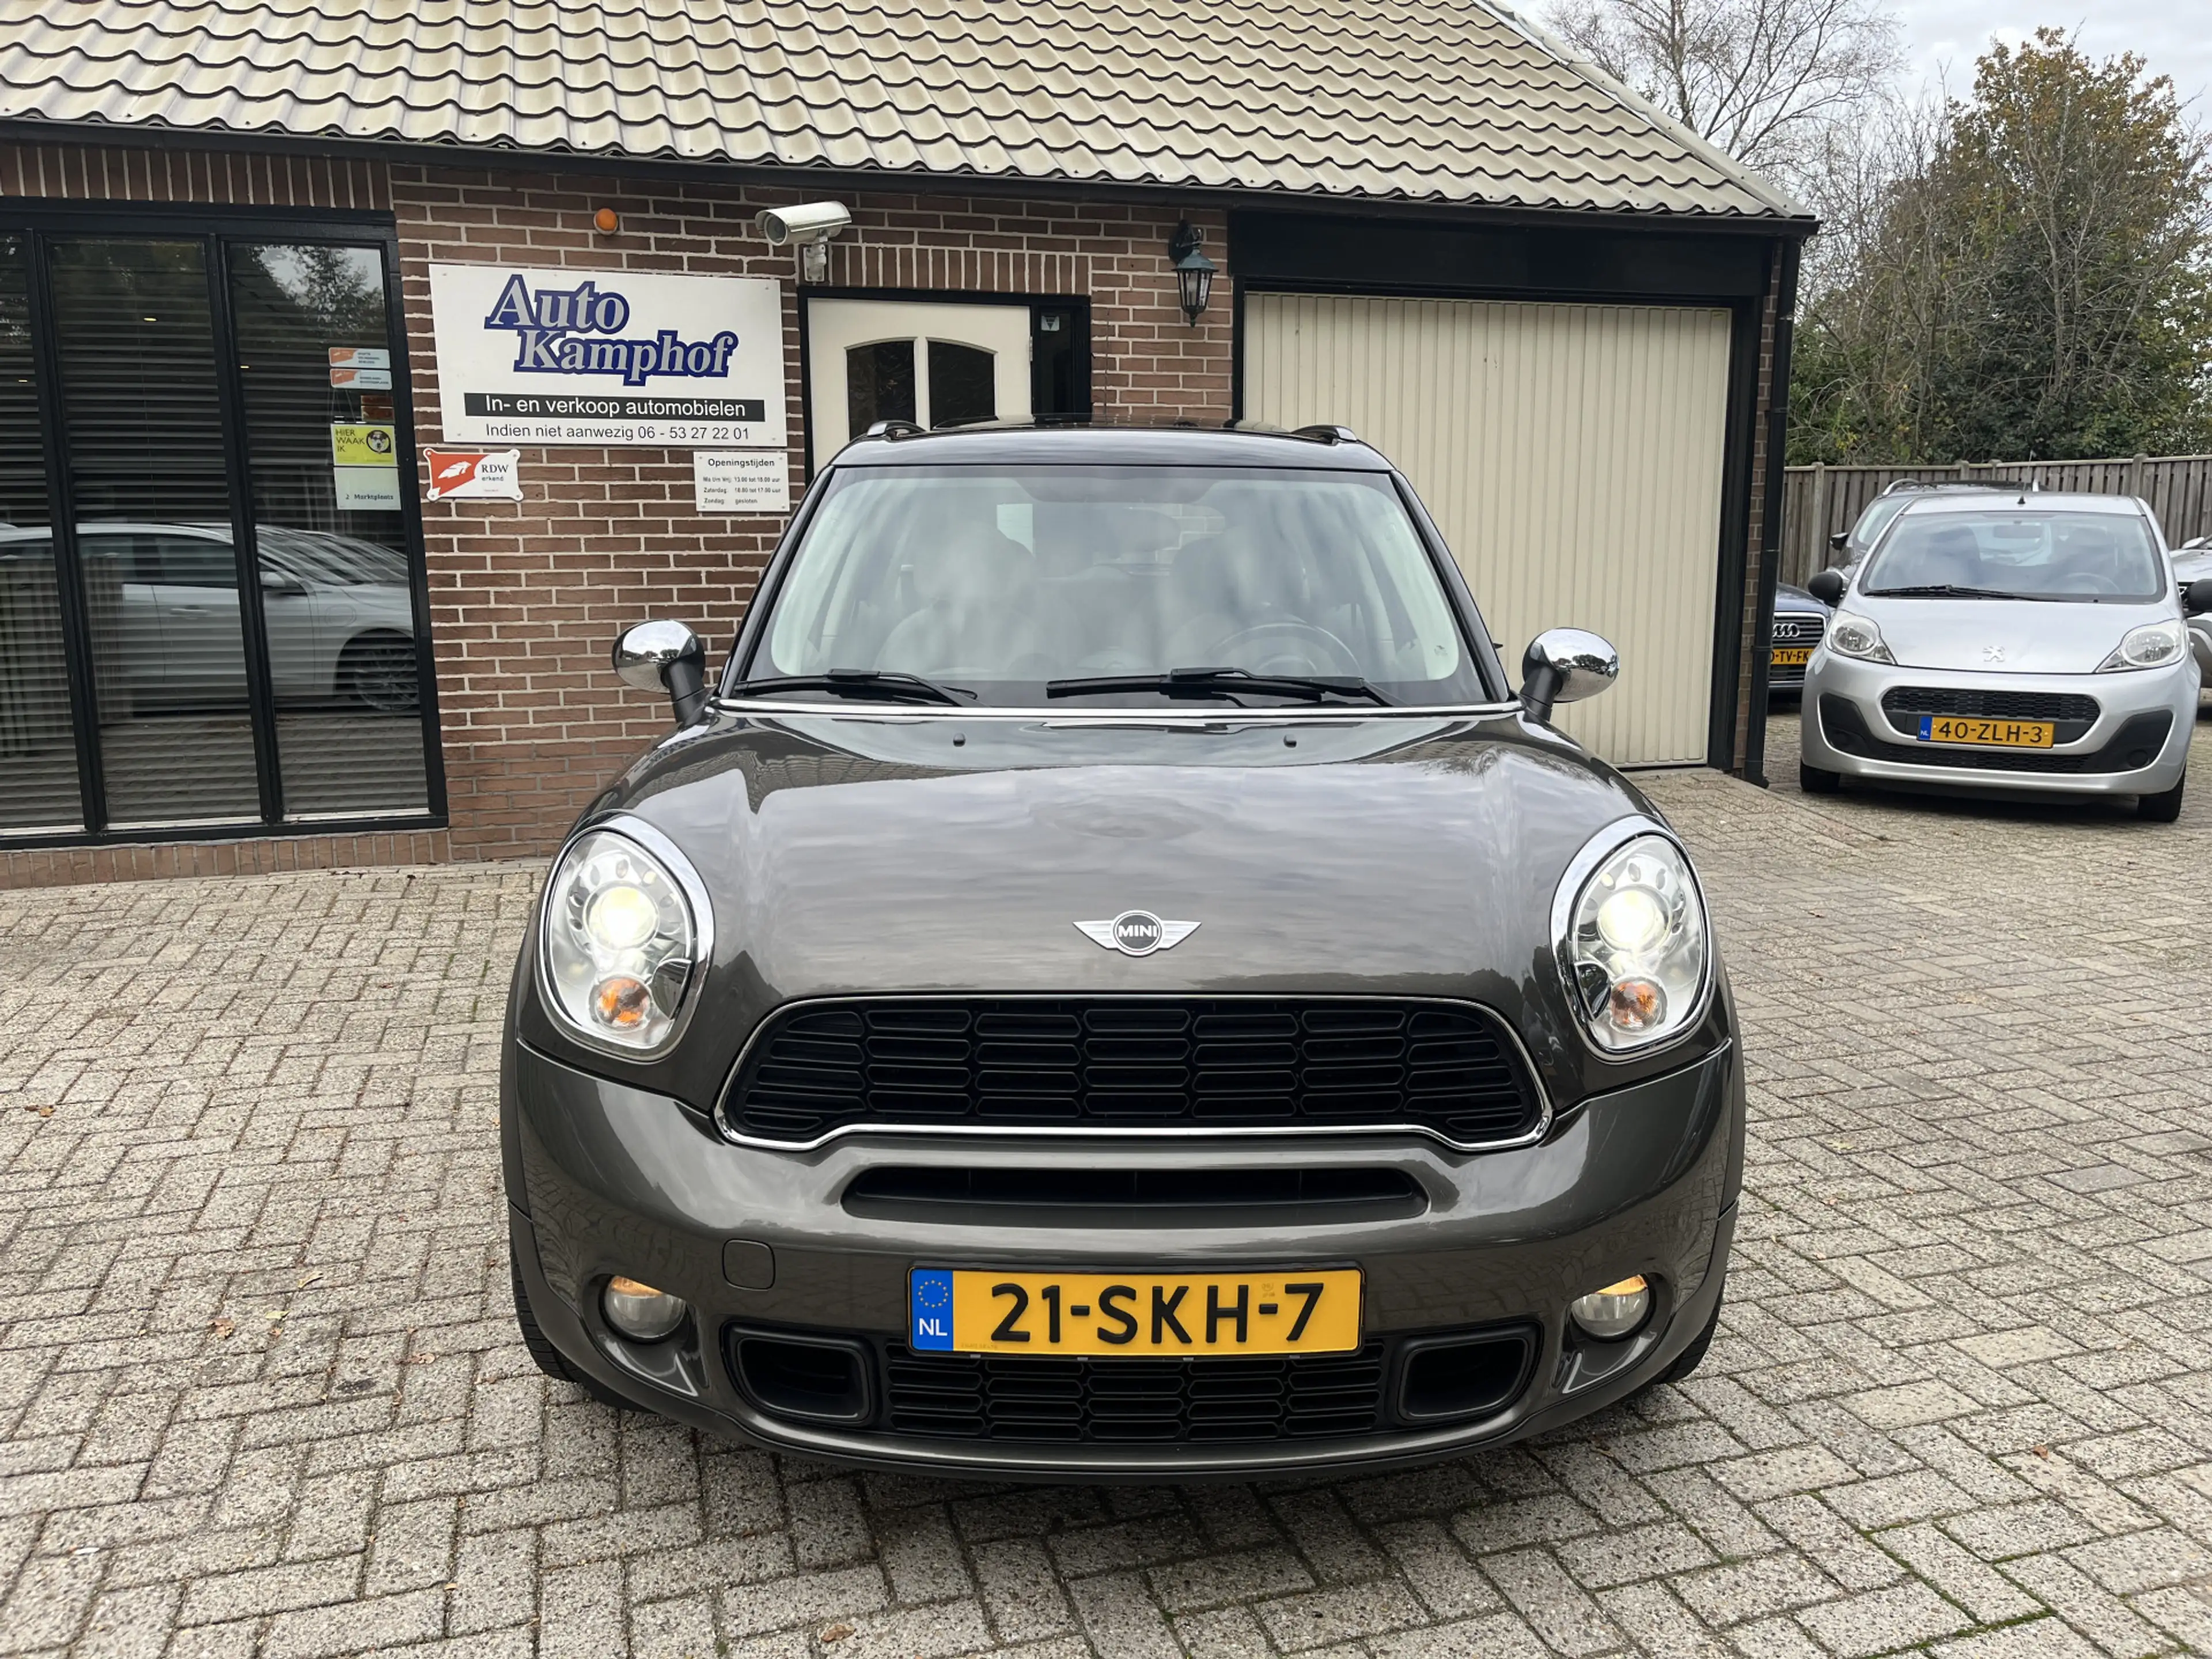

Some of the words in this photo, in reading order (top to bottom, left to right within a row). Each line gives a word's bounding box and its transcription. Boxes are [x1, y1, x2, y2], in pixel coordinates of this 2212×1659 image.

[485, 275, 629, 334] Auto
[514, 329, 738, 385] Kamphof
[486, 395, 511, 411] In-
[516, 399, 540, 412] en
[546, 397, 620, 418] verkoop
[626, 400, 745, 416] automobielen
[486, 423, 531, 436] Indien
[536, 424, 562, 437] niet
[567, 426, 633, 441] aanwezig
[638, 426, 655, 438] 06
[669, 427, 686, 439] 53
[691, 427, 707, 439] 27
[713, 427, 729, 440] 22
[733, 427, 748, 440] 01
[482, 464, 509, 473] RDW
[708, 459, 775, 468] Openingstijden
[1938, 721, 2043, 743] 40-ZLH-3
[1118, 925, 1158, 938] MINI
[919, 1317, 948, 1336] NL
[990, 1282, 1325, 1345] 21-SKH-7
